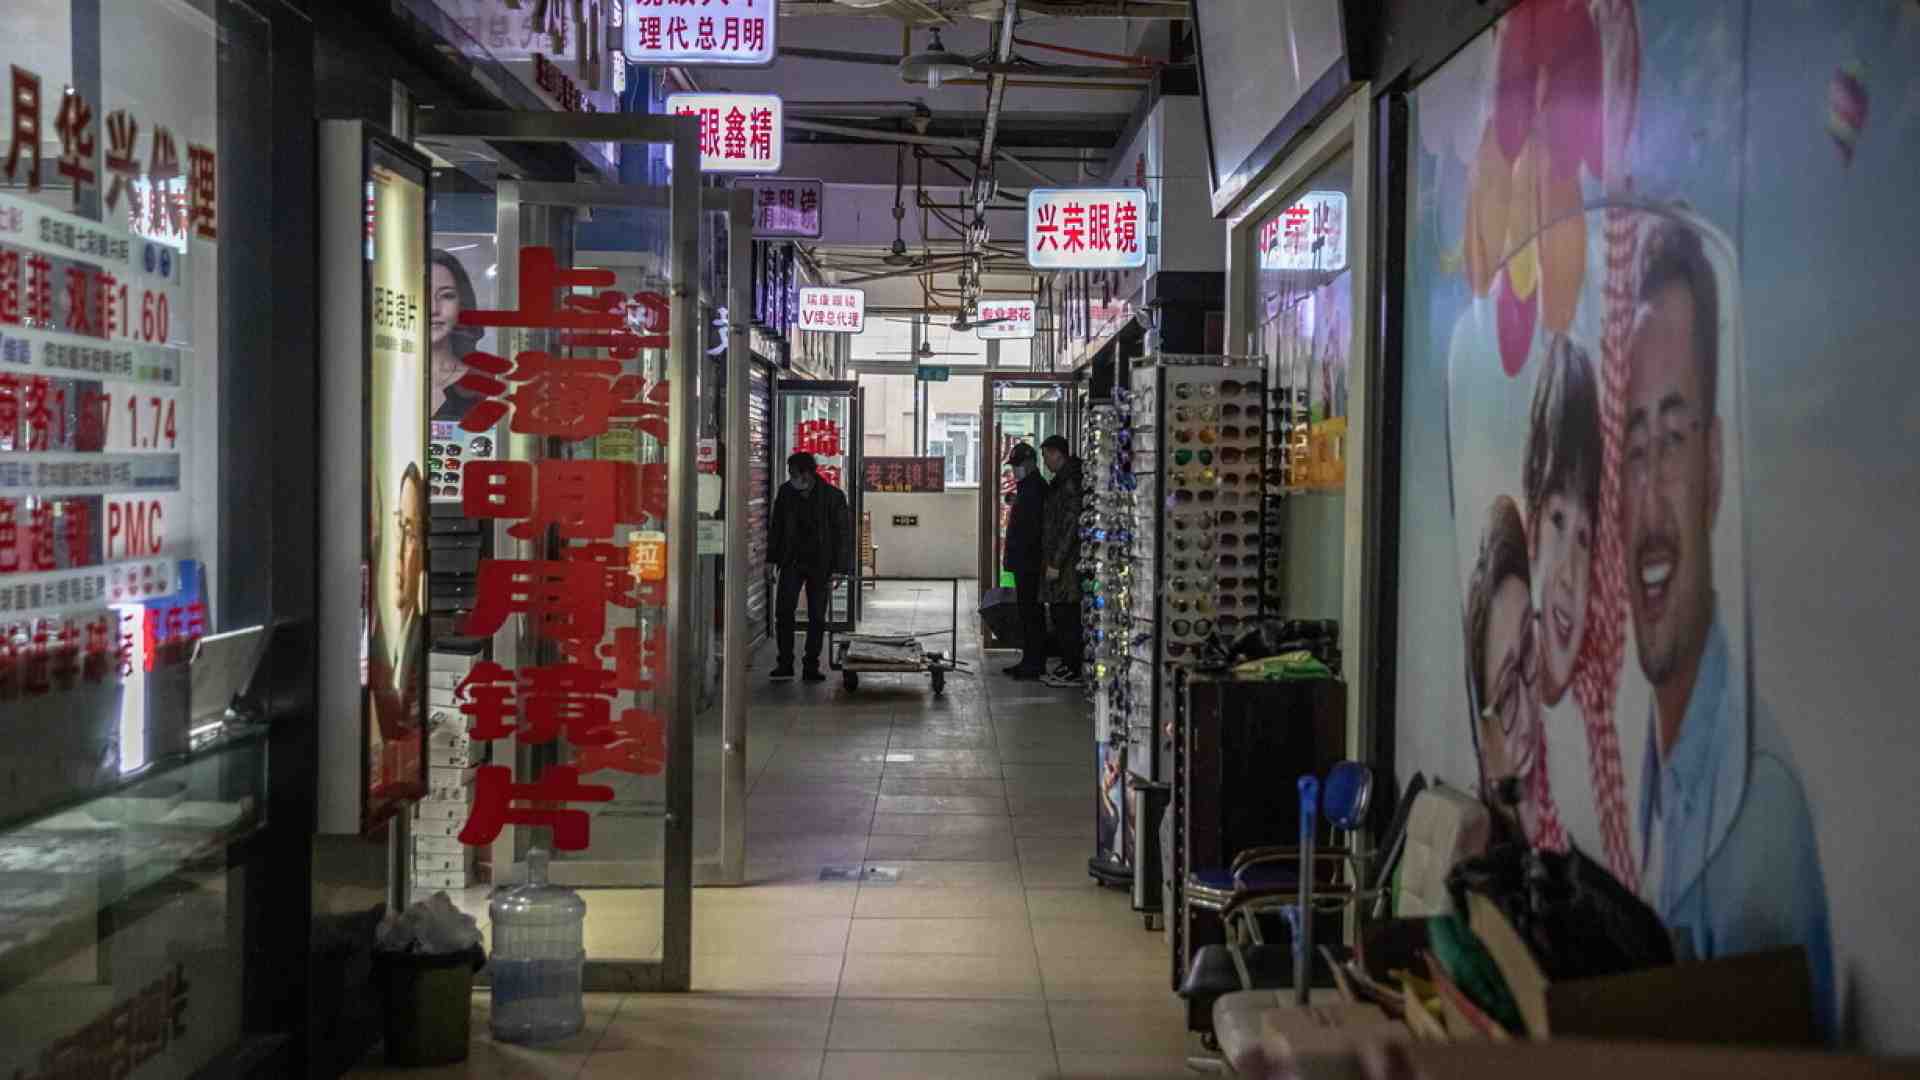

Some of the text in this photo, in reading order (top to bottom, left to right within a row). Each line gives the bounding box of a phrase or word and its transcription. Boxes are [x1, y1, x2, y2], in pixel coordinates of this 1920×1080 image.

[639, 16, 765, 51] 理代总月明
[674, 105, 773, 160] 眼鑫精
[1036, 201, 1138, 253] 兴荣眼镜
[128, 394, 176, 449] 1.74
[107, 500, 162, 558] PMC
